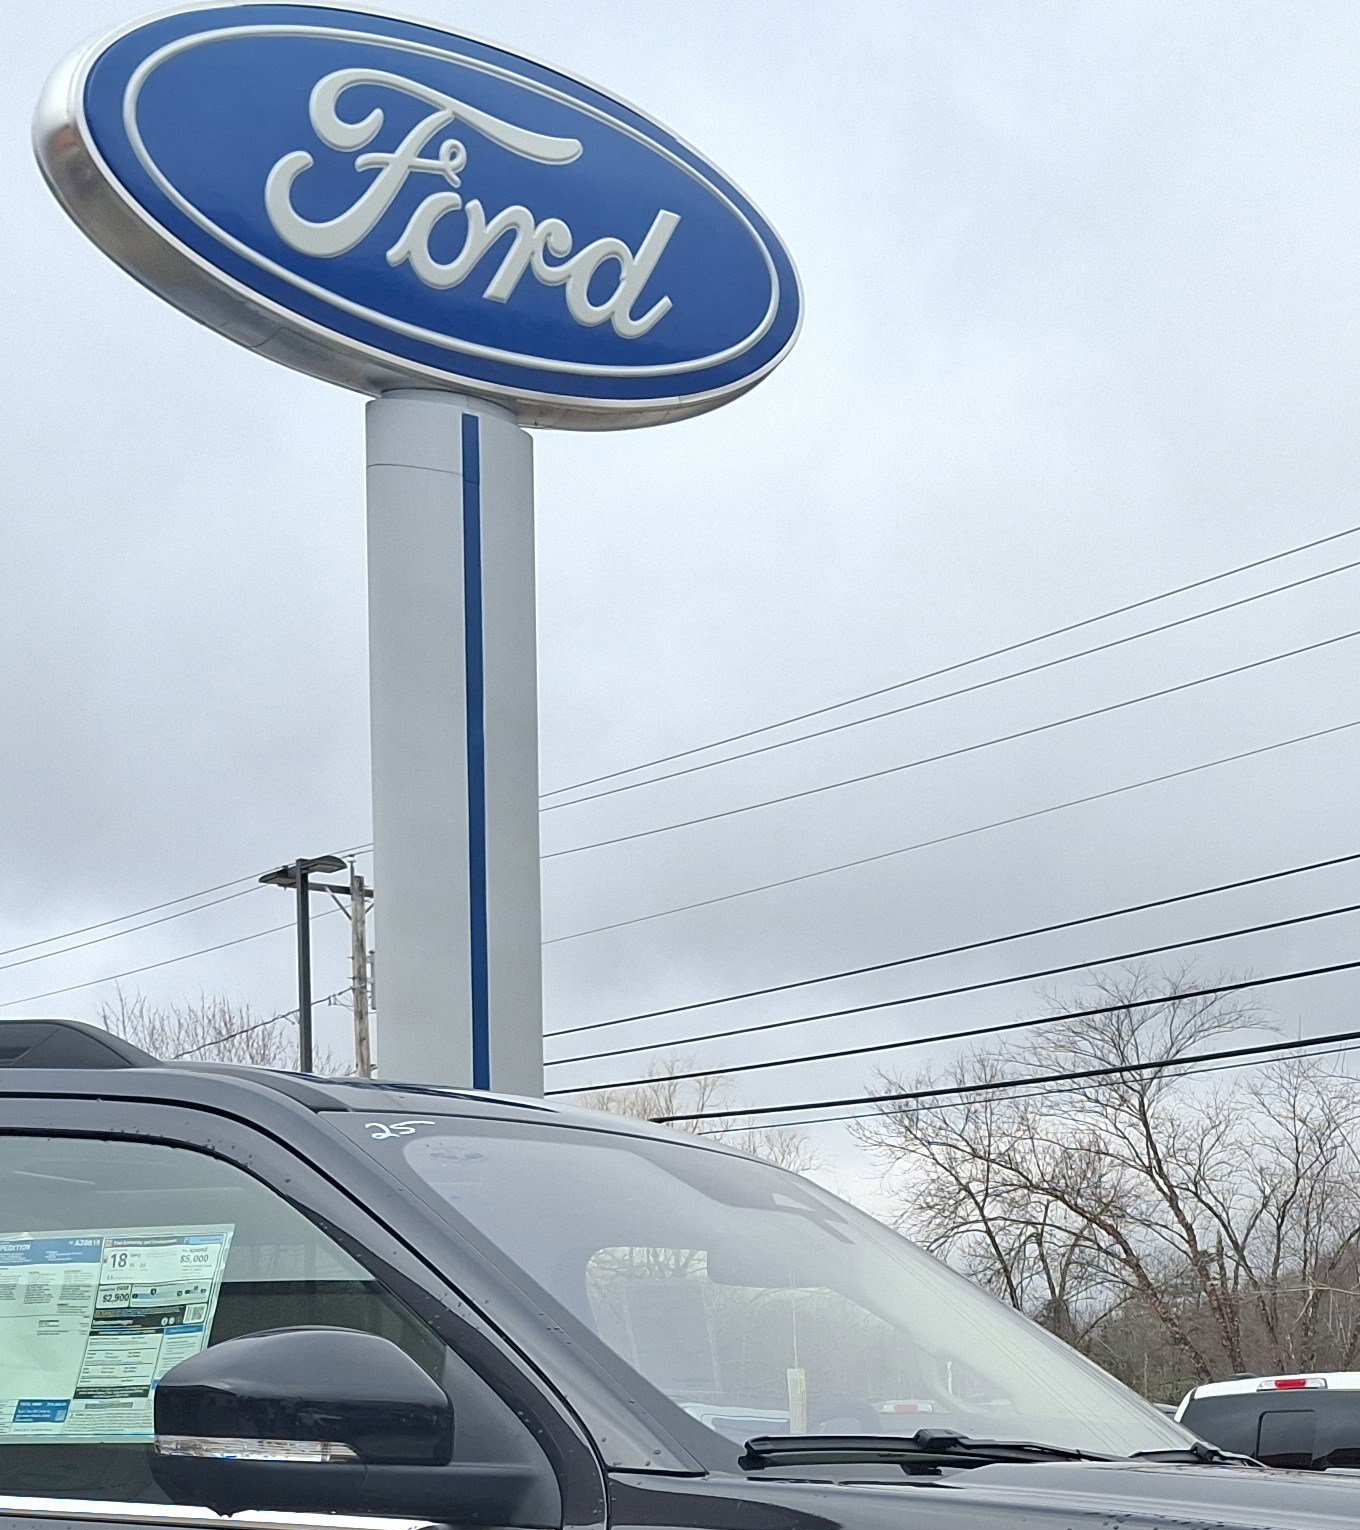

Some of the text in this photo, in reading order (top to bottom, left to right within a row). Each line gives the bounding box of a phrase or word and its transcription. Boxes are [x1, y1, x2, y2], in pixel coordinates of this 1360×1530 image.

[265, 67, 682, 339] Ford
[365, 1120, 435, 1140] 25
[110, 1252, 128, 1268] 18
